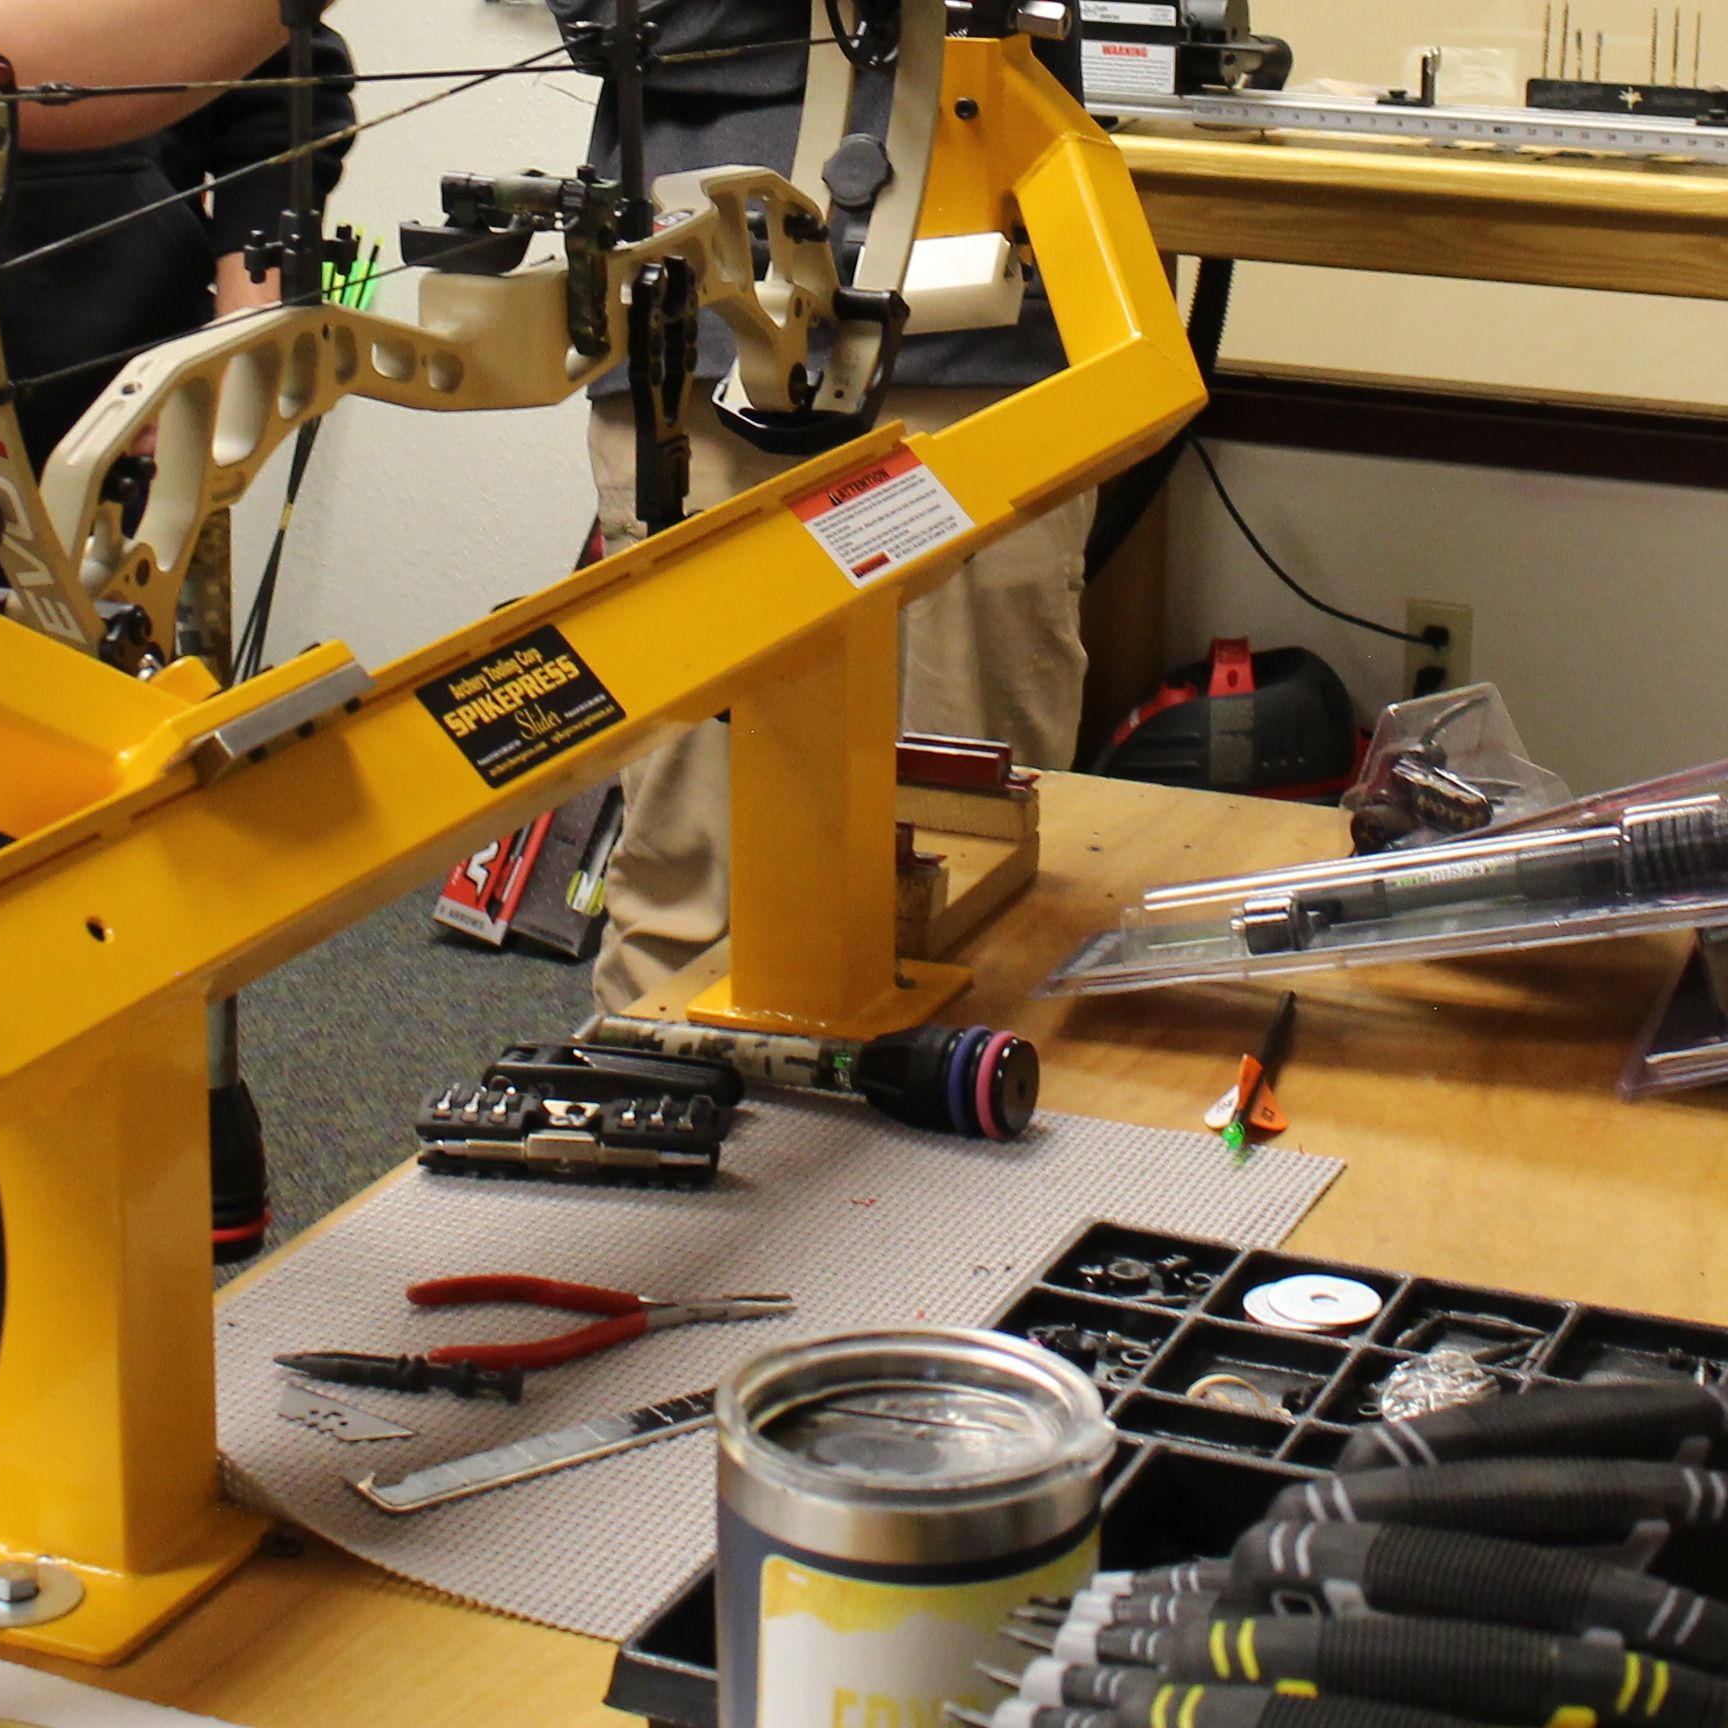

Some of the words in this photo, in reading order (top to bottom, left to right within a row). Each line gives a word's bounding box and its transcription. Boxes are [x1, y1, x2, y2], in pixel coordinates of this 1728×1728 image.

[442, 653, 581, 739] SPIKEPRESS
[447, 672, 493, 702] Archery
[481, 656, 524, 683] Tooling
[513, 646, 544, 668] Corp
